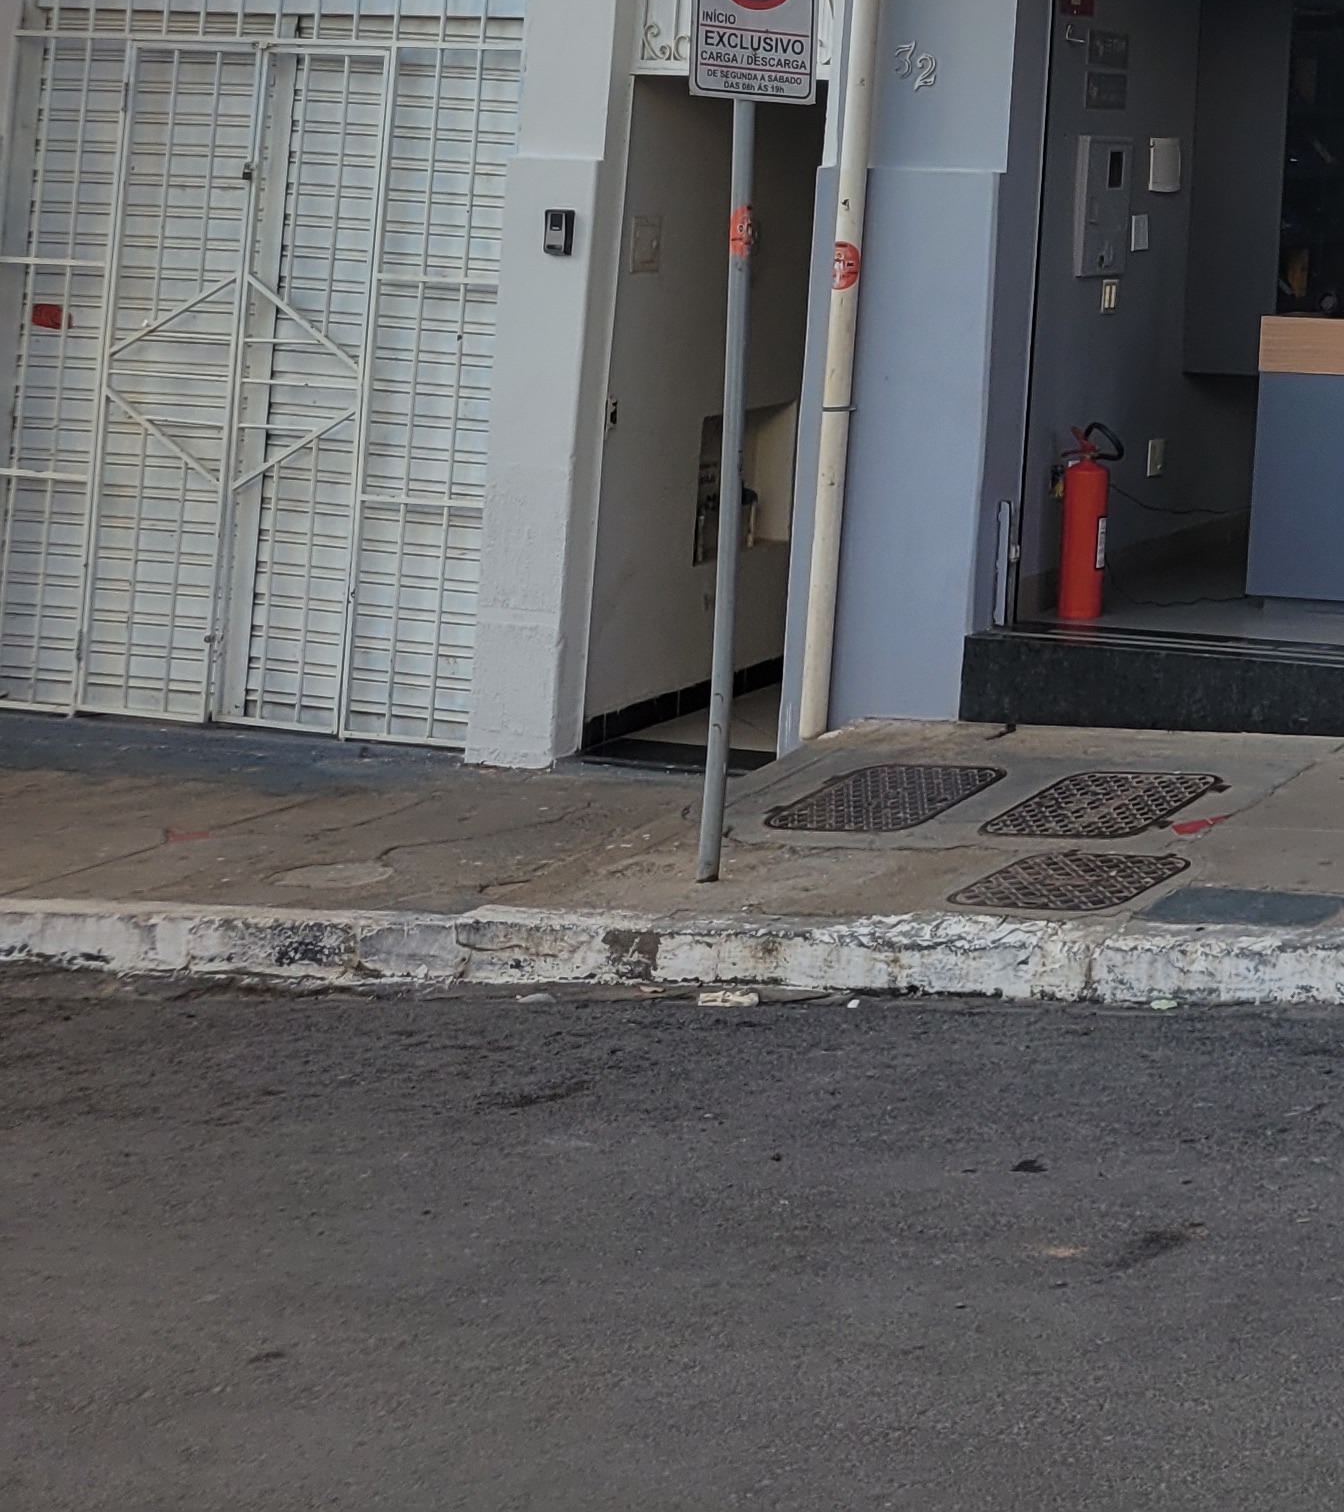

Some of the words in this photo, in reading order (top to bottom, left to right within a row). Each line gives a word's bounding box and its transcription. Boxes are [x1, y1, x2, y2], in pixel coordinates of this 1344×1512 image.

[702, 8, 736, 25] INÍCIO
[704, 29, 804, 55] EXCLUSIVO
[700, 50, 738, 64] CARGA
[746, 54, 807, 70] DESCARGA
[894, 39, 937, 92] 32
[707, 69, 718, 77] DE
[720, 70, 758, 81] SEGUNDA
[767, 74, 802, 85] SÁBADO
[724, 80, 740, 89] DAS
